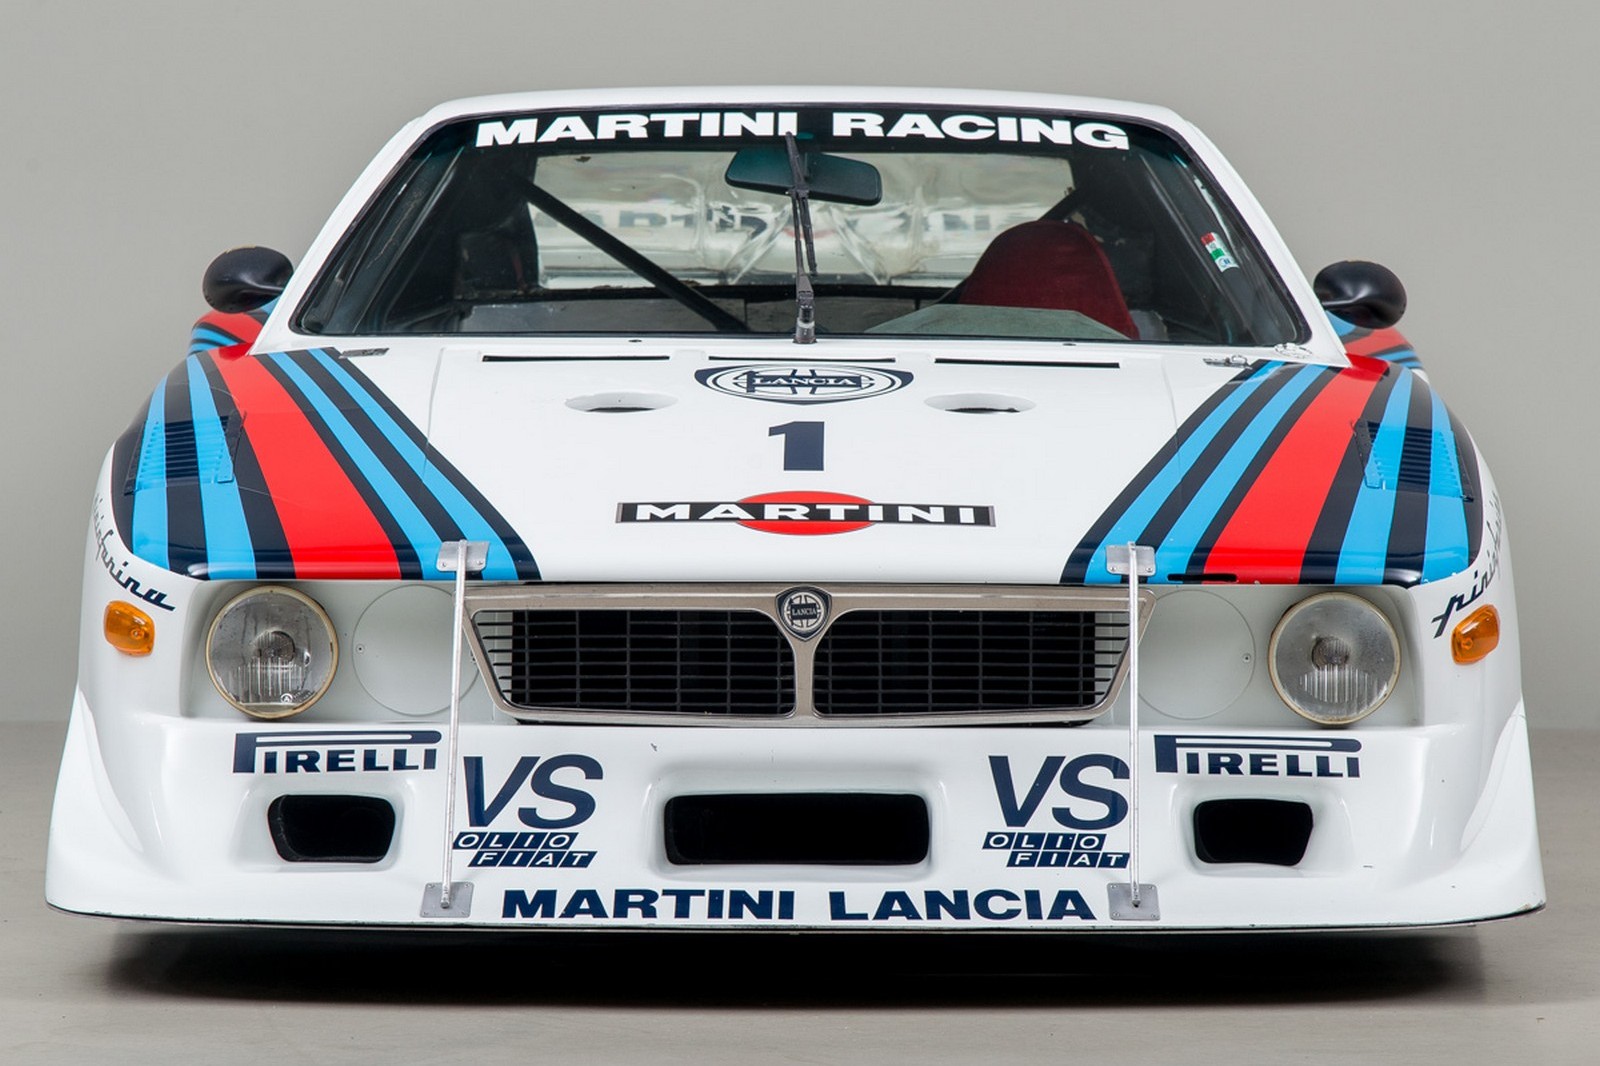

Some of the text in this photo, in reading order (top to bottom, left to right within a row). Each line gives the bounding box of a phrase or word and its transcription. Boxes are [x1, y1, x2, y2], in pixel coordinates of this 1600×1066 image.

[475, 112, 1131, 150] MARTINI RACING
[752, 376, 859, 387] LANCIA
[769, 421, 824, 471] 1
[635, 502, 976, 525] MARTINI
[791, 606, 818, 617] LANCIA
[233, 730, 442, 774] PIRELLI
[1154, 734, 1362, 778] PIRELLI
[463, 754, 603, 829] VS
[988, 754, 1130, 830] VS
[456, 833, 573, 848] OLIO
[987, 833, 1101, 849] OLIO
[475, 852, 590, 866] FIAT
[1013, 852, 1125, 867] FIAT
[502, 888, 1097, 921] MARTINI LANCIA
